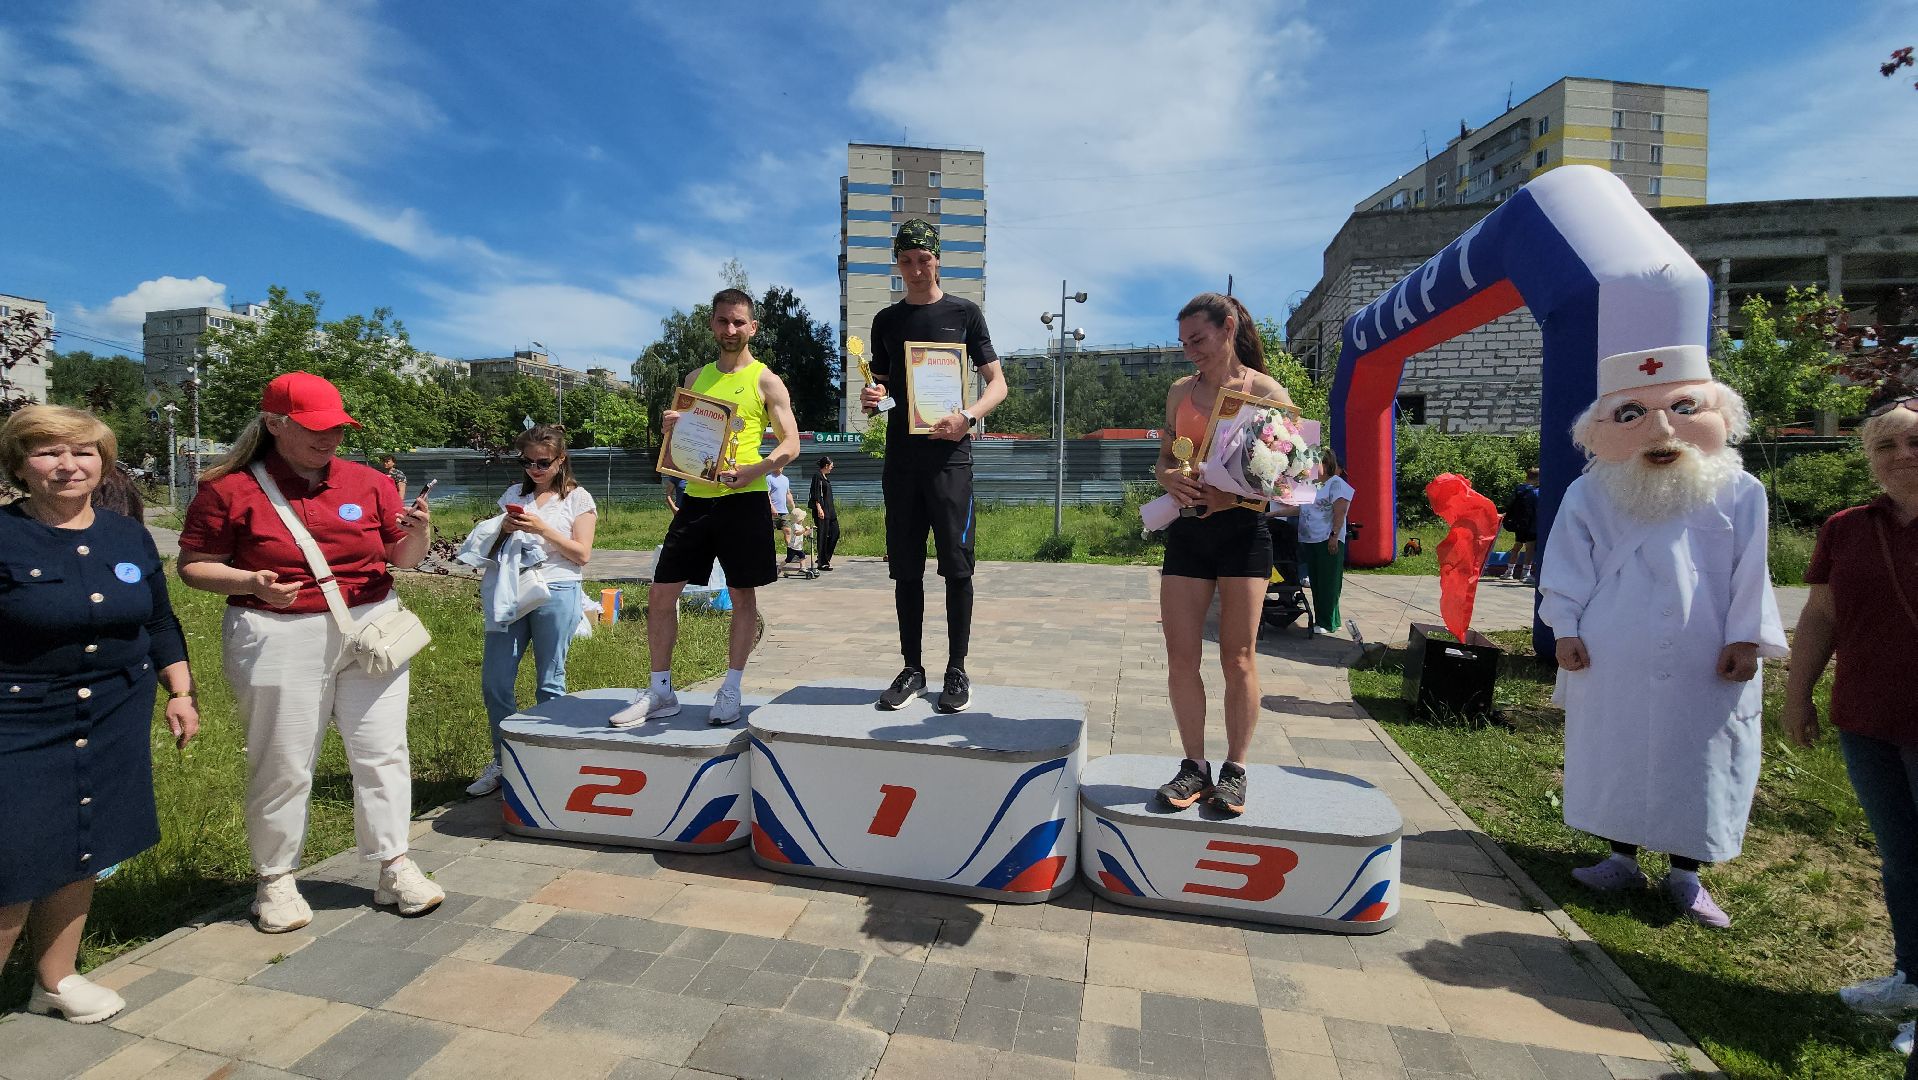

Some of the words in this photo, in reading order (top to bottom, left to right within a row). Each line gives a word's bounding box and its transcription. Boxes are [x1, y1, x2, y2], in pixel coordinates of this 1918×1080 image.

[1352, 220, 1486, 351] СТАРТ
[927, 358, 957, 366] ДИПЛОМ
[693, 407, 725, 421] ДИПЛОМ
[565, 766, 646, 815] 2
[868, 784, 916, 838] 1
[1182, 840, 1299, 902] 3
